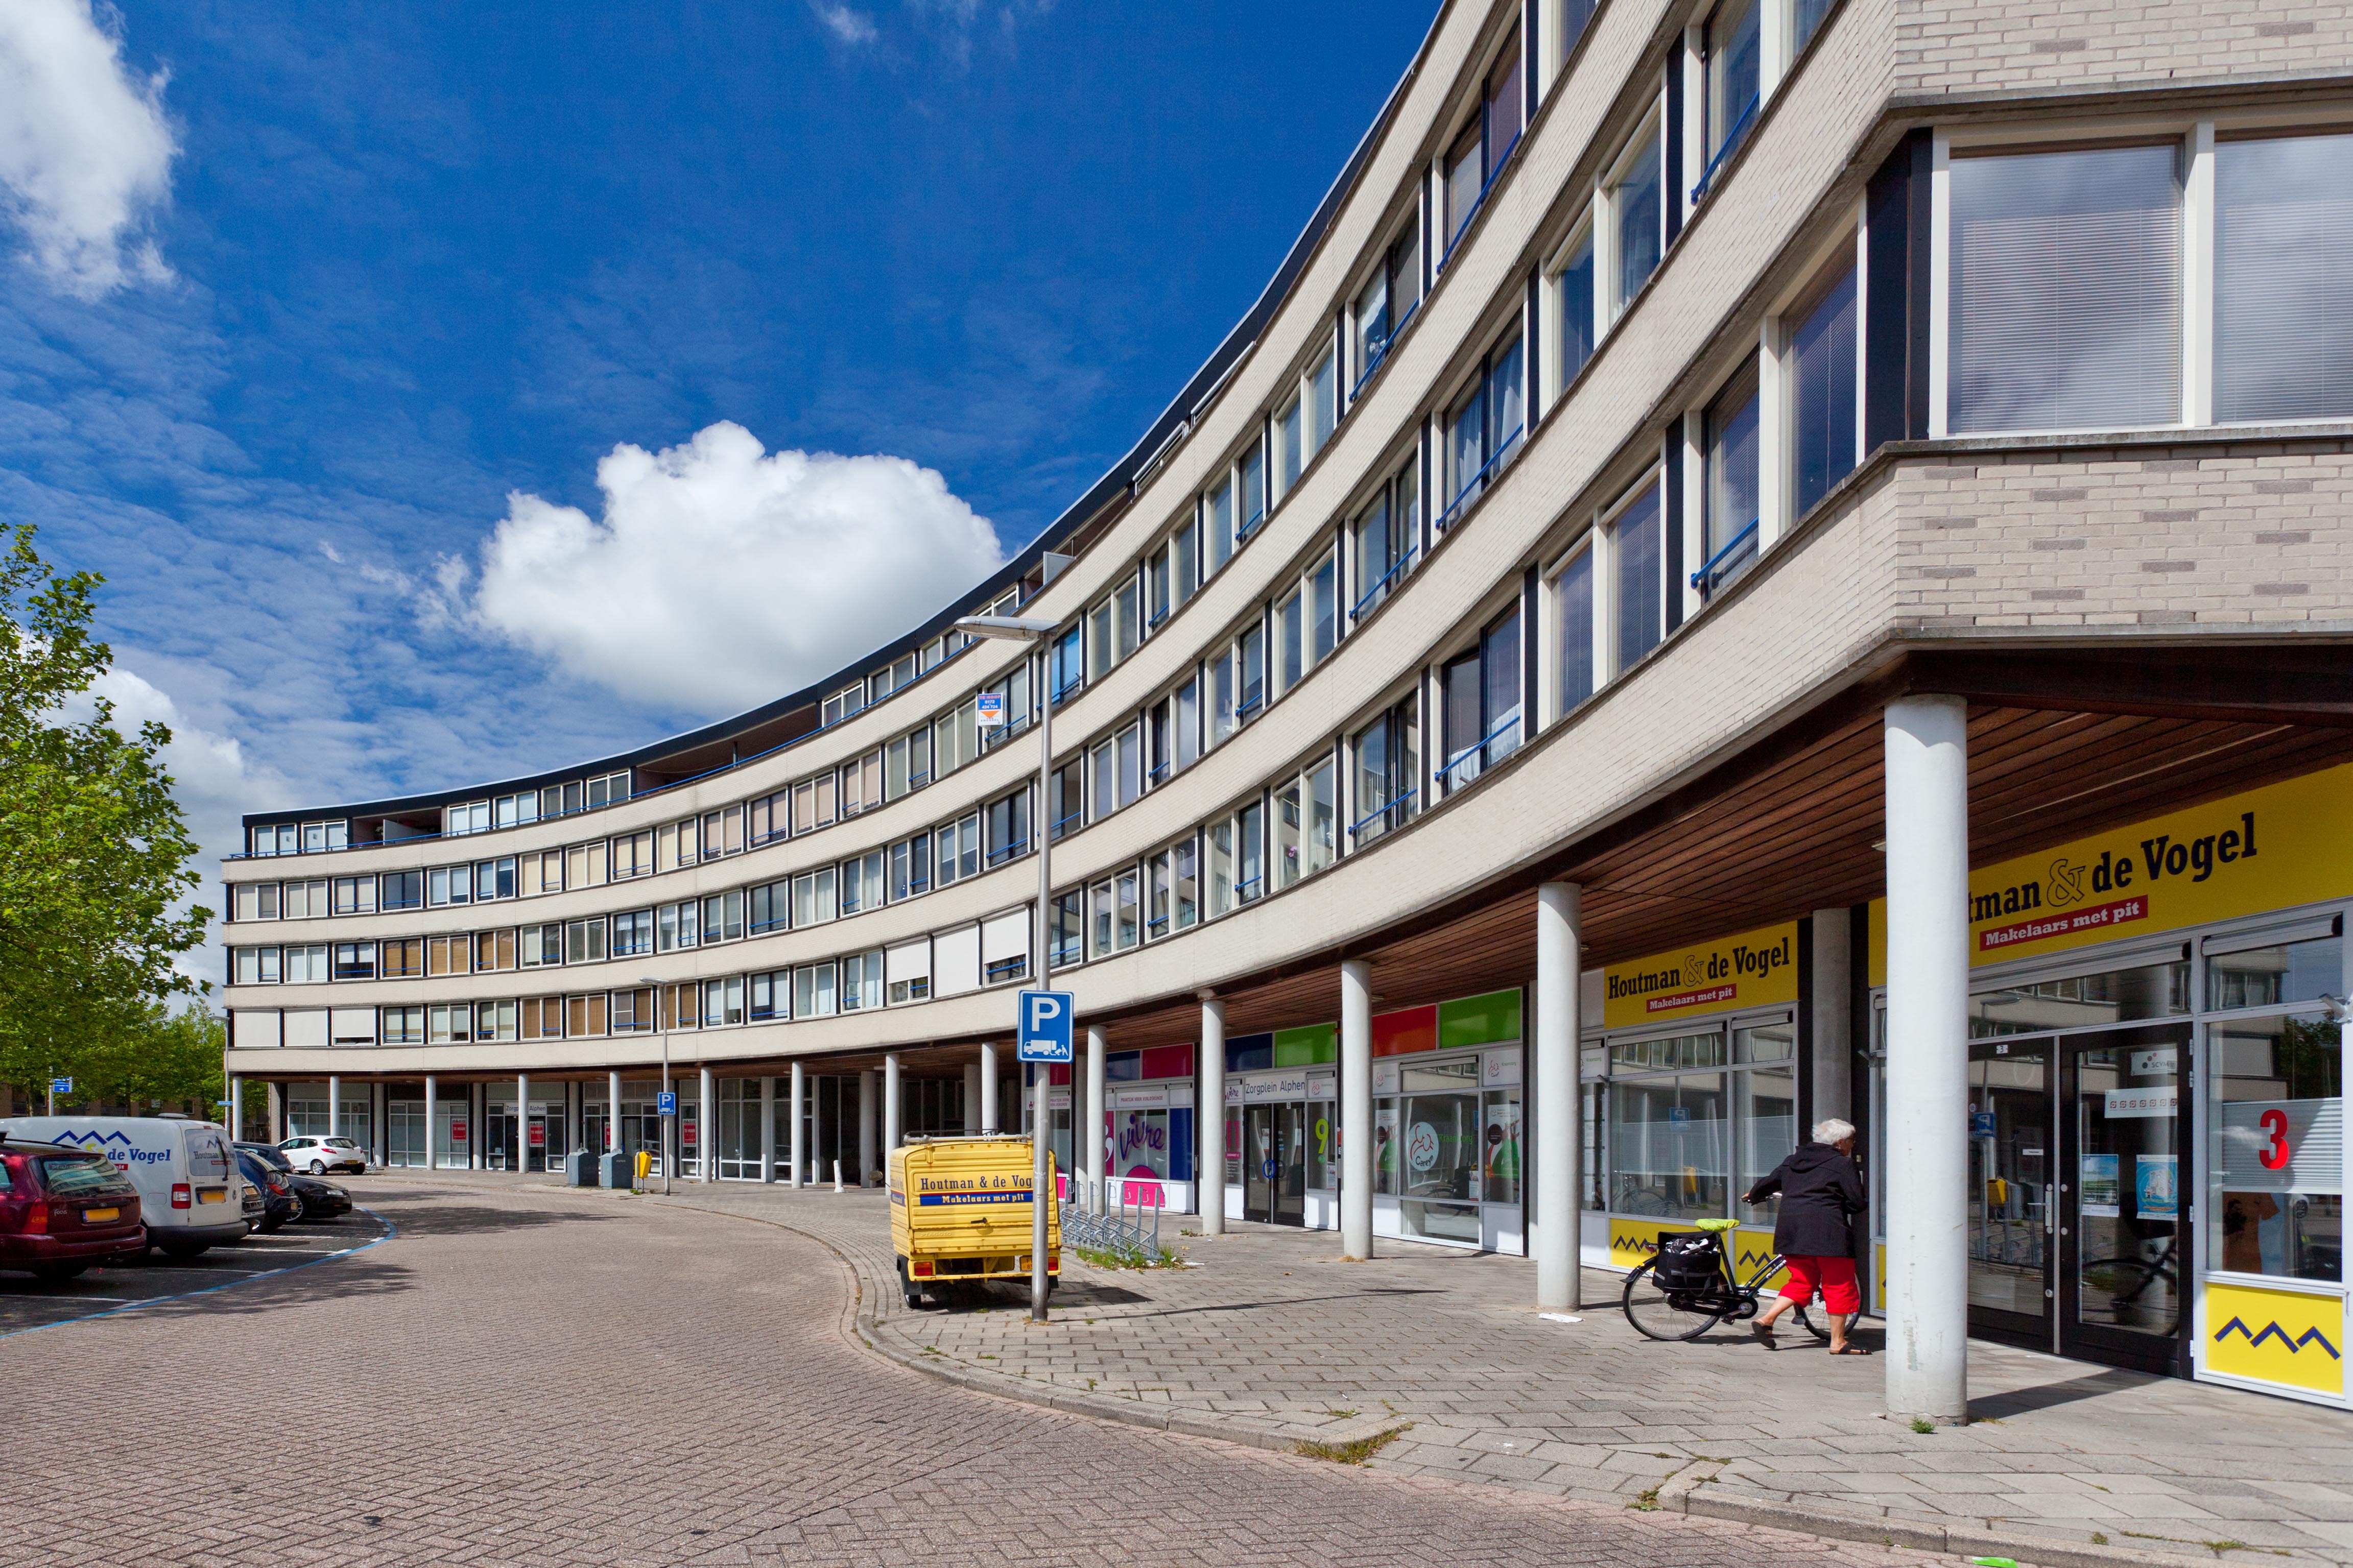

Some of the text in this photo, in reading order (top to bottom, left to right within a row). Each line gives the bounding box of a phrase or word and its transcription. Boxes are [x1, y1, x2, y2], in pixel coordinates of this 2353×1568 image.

[2047, 859, 2085, 907] &
[2092, 851, 2132, 893] de
[2141, 812, 2257, 882] Vogel
[1986, 901, 2140, 946] Makelaars met pit
[1608, 936, 1790, 999] Houtman & de Vogel
[1650, 987, 1732, 1009] Makelaars met pit
[1032, 997, 1060, 1031] P
[662, 1095, 671, 1105] P
[1246, 1080, 1305, 1095] Zorgplein Alphen
[1120, 1113, 1165, 1161] vivre
[1315, 1119, 1328, 1154] 9
[2259, 1109, 2289, 1170] 3
[108, 1148, 125, 1160] de
[129, 1149, 171, 1164] Vogel
[1415, 1155, 1434, 1167] Careyn
[920, 1178, 974, 1191] Houtman
[979, 1176, 988, 1188] &
[993, 1176, 1006, 1188] de
[942, 1194, 991, 1203] Makelaars
[1012, 1193, 1025, 1202] pit
